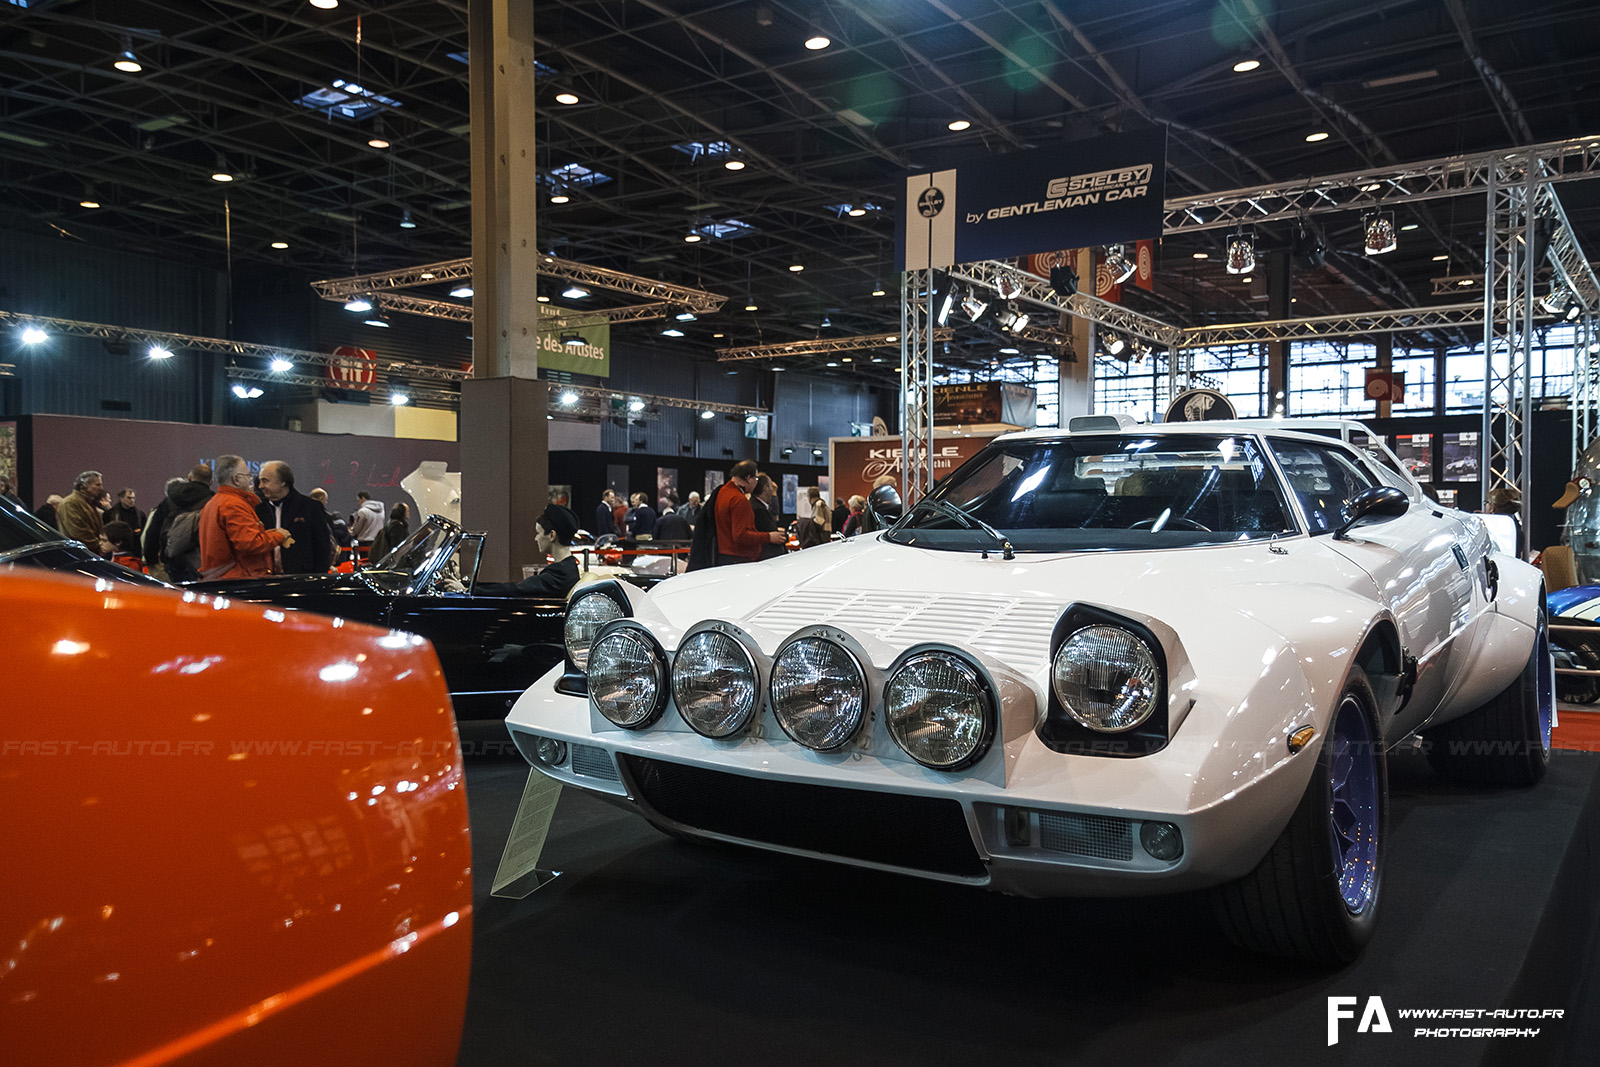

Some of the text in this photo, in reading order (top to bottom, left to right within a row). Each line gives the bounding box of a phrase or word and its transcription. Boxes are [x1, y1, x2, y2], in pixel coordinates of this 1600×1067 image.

[1068, 168, 1147, 191] SHELBY
[965, 184, 1148, 224] by GENTLEMAN CAR
[543, 332, 563, 353] des
[565, 343, 604, 360] Artistes
